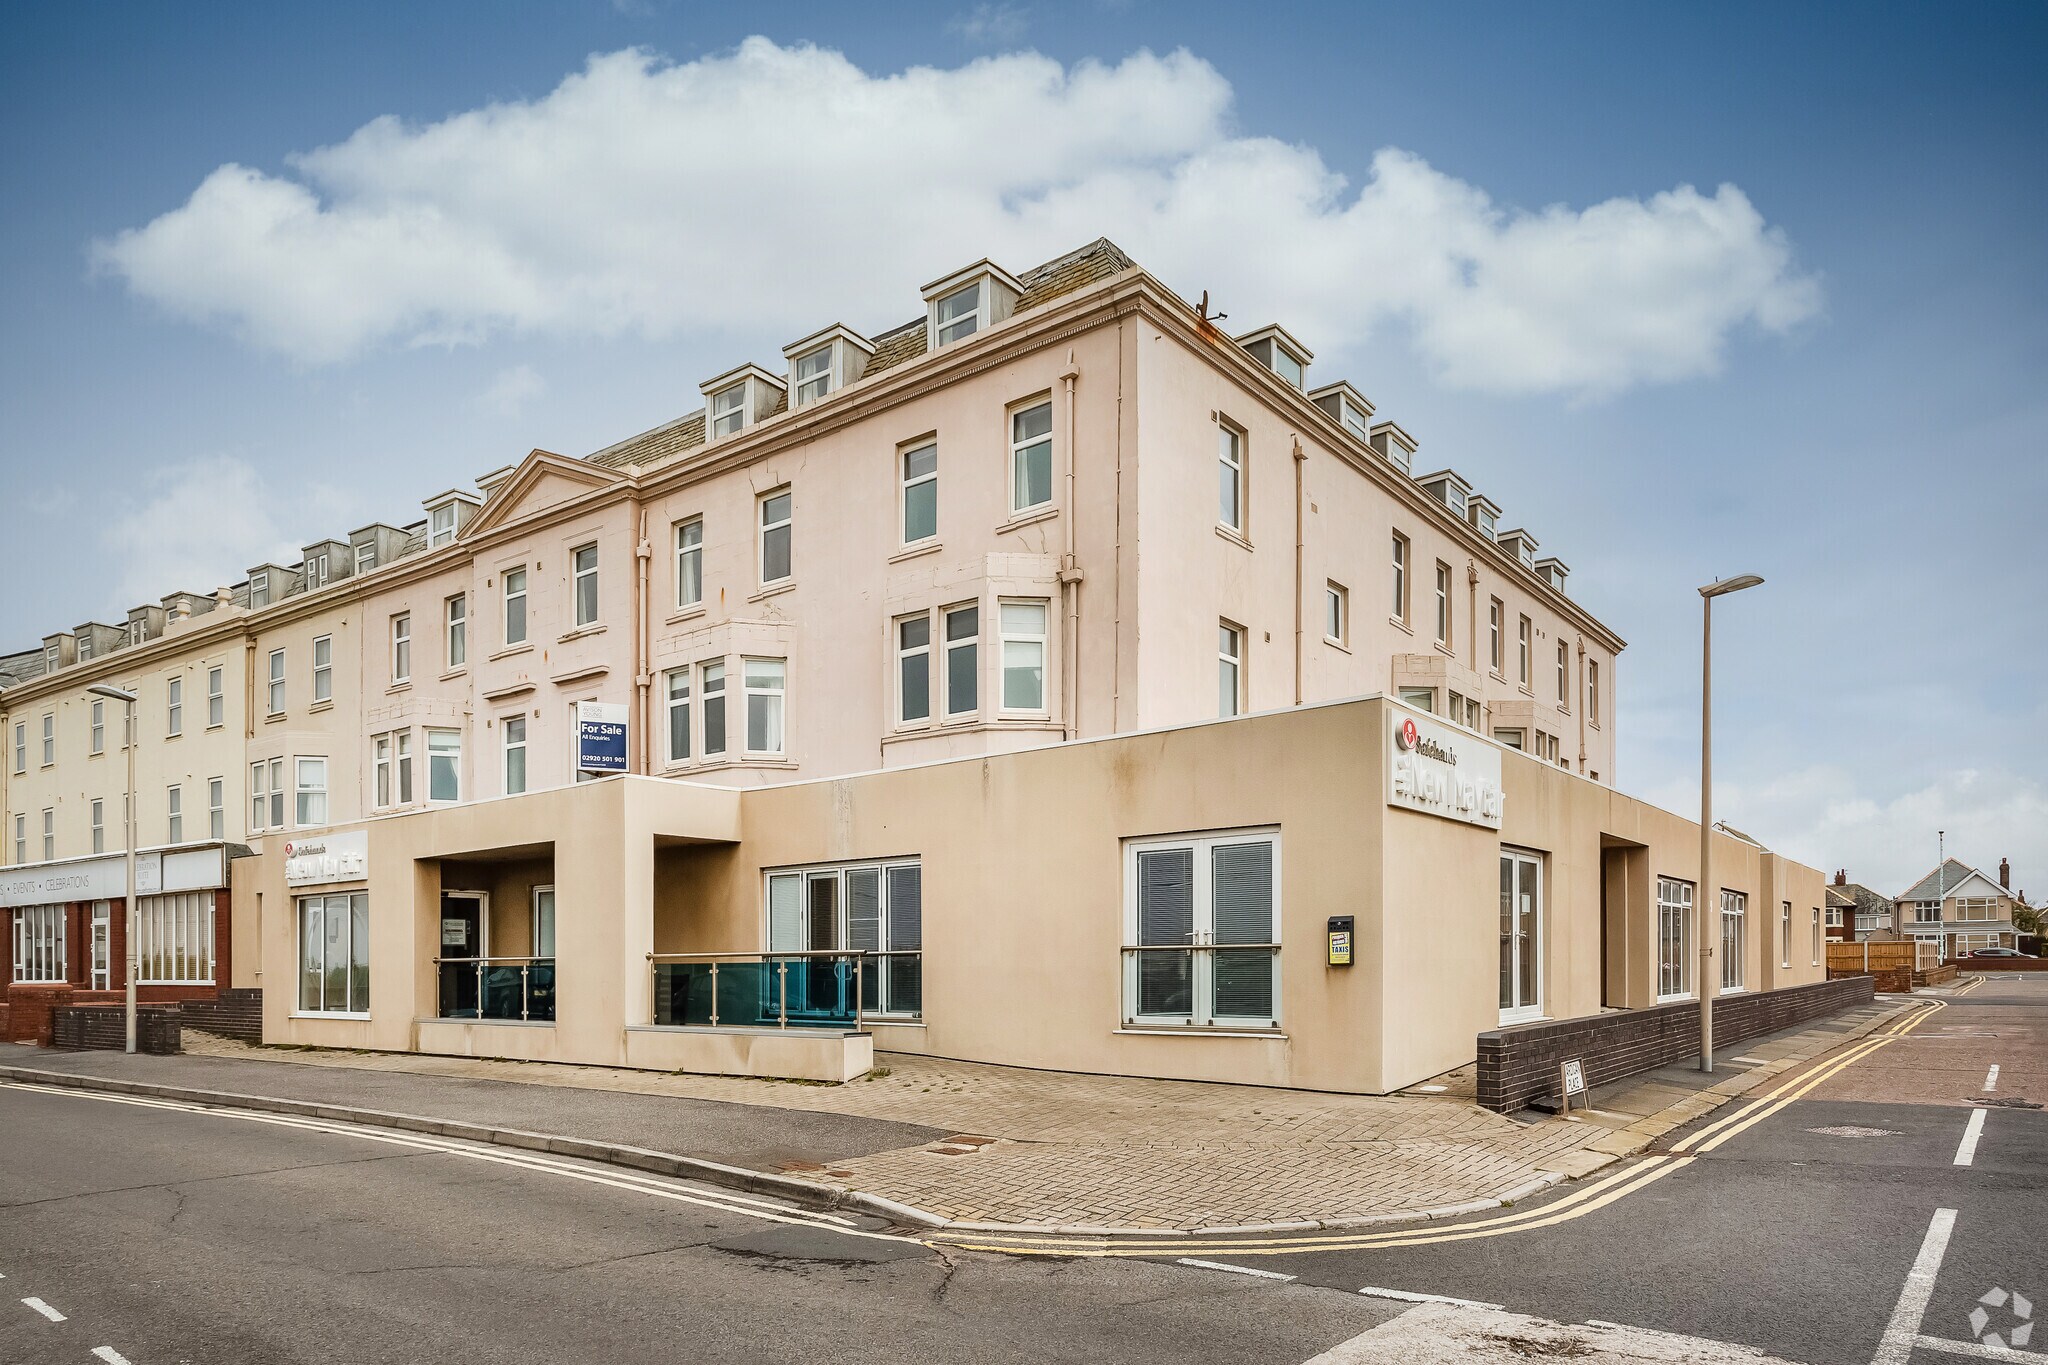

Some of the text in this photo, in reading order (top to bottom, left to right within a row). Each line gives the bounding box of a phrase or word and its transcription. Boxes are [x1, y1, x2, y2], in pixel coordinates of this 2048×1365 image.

[582, 724, 622, 735] For Sale
[1415, 735, 1457, 766] Safehands
[13, 881, 35, 894] EVENTS
[46, 875, 89, 891] CELEBRATIONS
